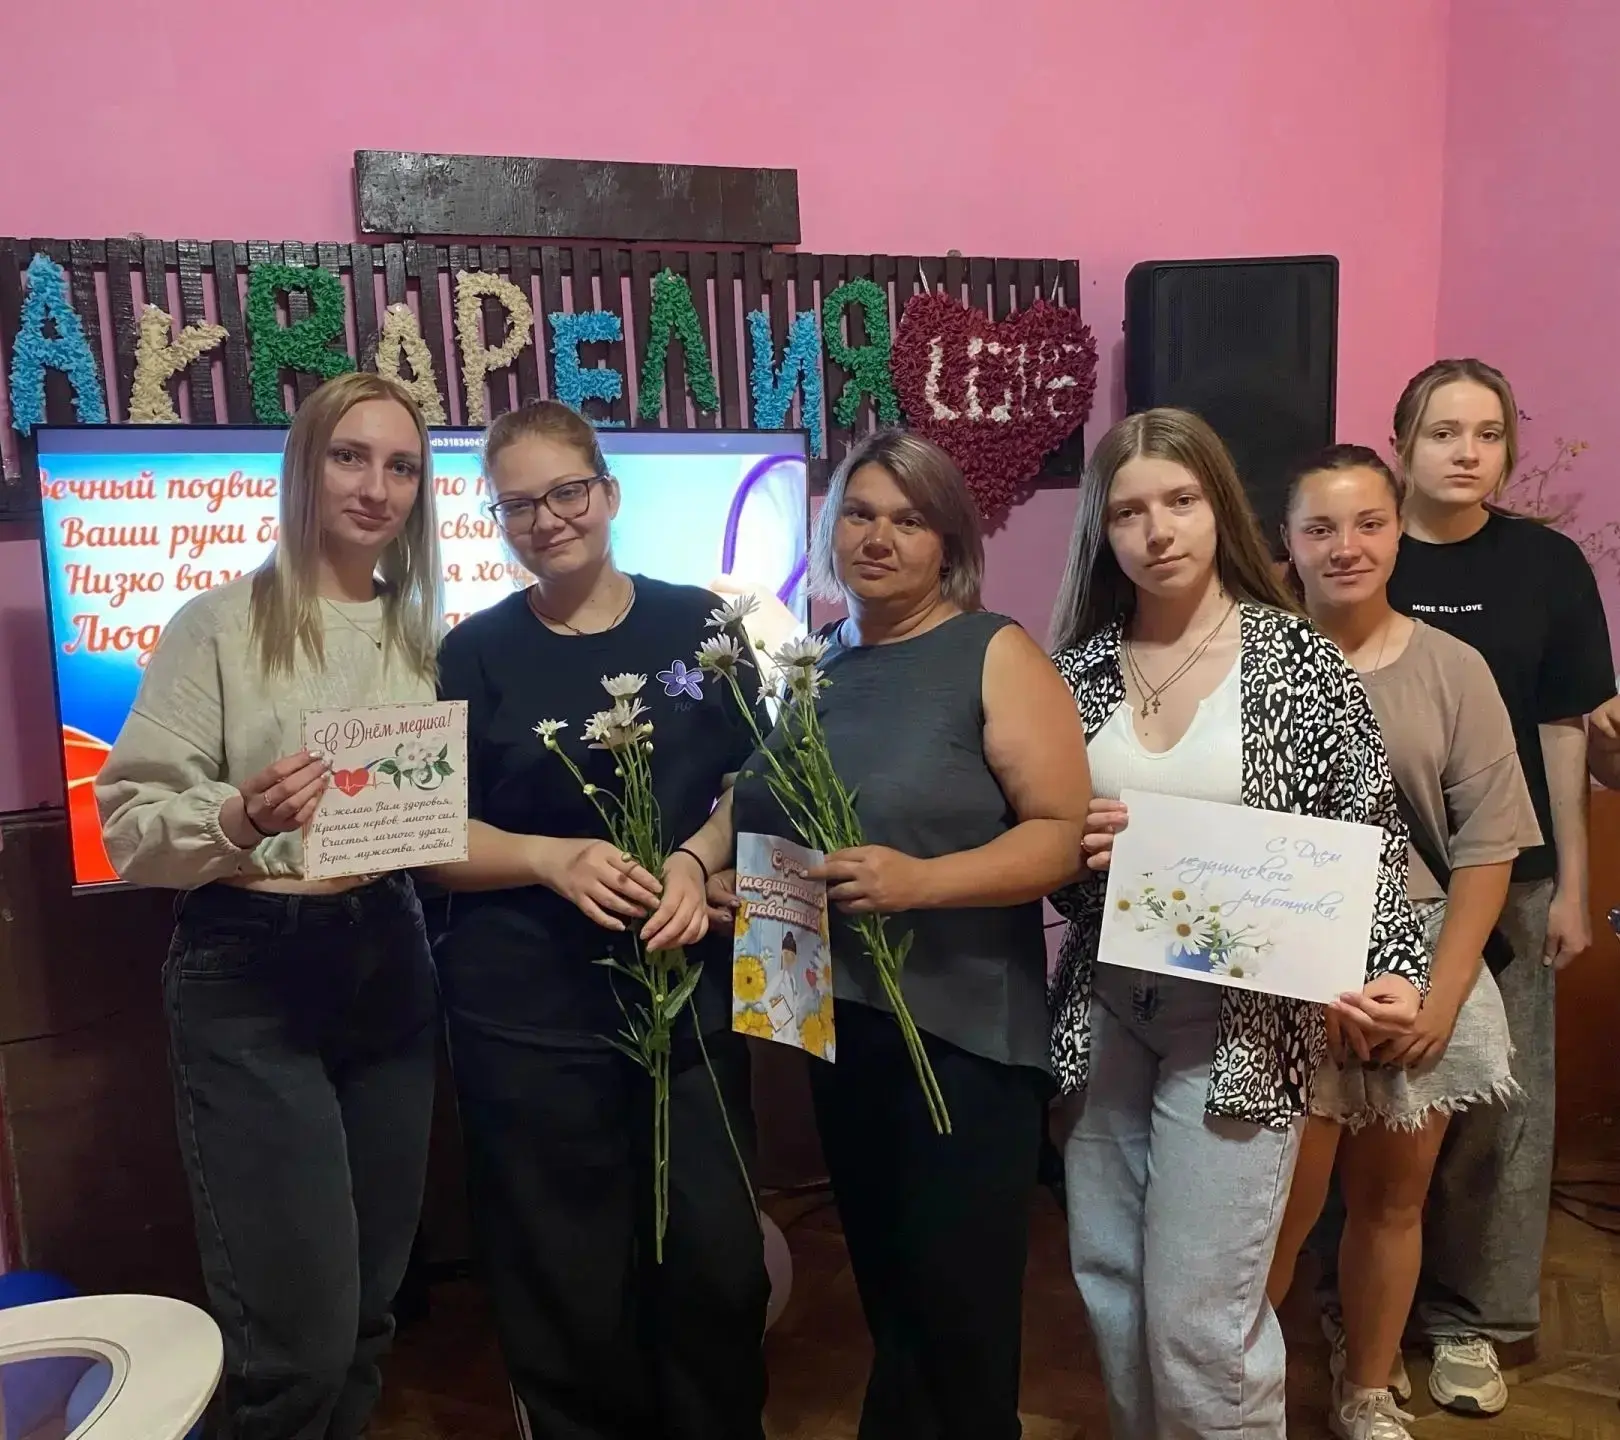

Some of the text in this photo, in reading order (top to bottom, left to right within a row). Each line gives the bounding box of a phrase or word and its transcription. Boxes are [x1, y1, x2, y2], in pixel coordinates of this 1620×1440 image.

[167, 470, 278, 514] подвиг
[60, 516, 160, 548] Ваши
[169, 522, 247, 559] руки
[64, 563, 165, 608] Низко
[1412, 603, 1484, 614] MORE SELF LOVE
[63, 614, 162, 667] Люд
[314, 708, 453, 755] С Днём медика!
[312, 821, 360, 836] Крепких
[402, 812, 435, 824] много
[318, 807, 329, 818] Я
[333, 805, 373, 817] желаю
[375, 800, 401, 813] Вам
[321, 834, 369, 848] Счастья
[418, 837, 455, 851] любви!
[1265, 836, 1288, 853] С
[1159, 855, 1294, 885] медицинского
[1219, 887, 1345, 921] работника
